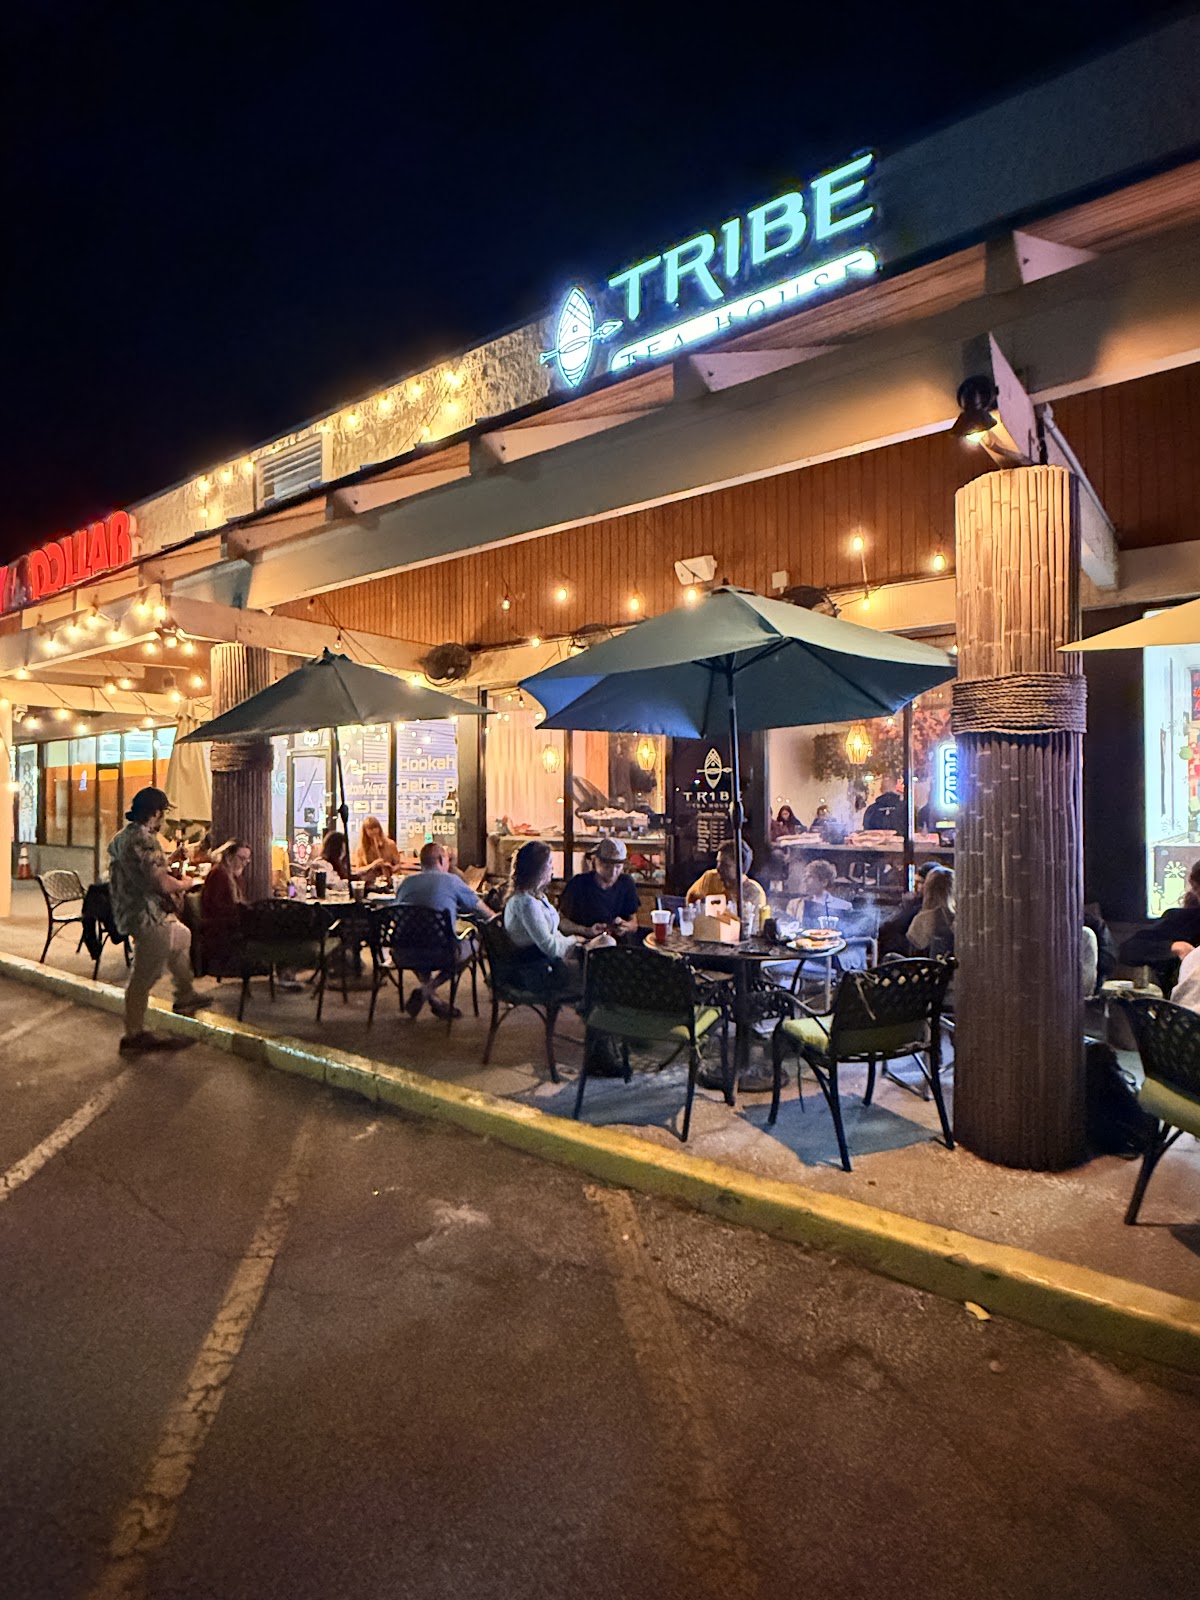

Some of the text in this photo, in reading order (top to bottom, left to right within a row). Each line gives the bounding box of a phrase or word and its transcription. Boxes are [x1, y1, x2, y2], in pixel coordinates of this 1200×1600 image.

[608, 153, 874, 321] TRIBE
[28, 509, 133, 601] DOLLAR
[400, 755, 455, 771] Hookah
[683, 791, 742, 803] TRIB
